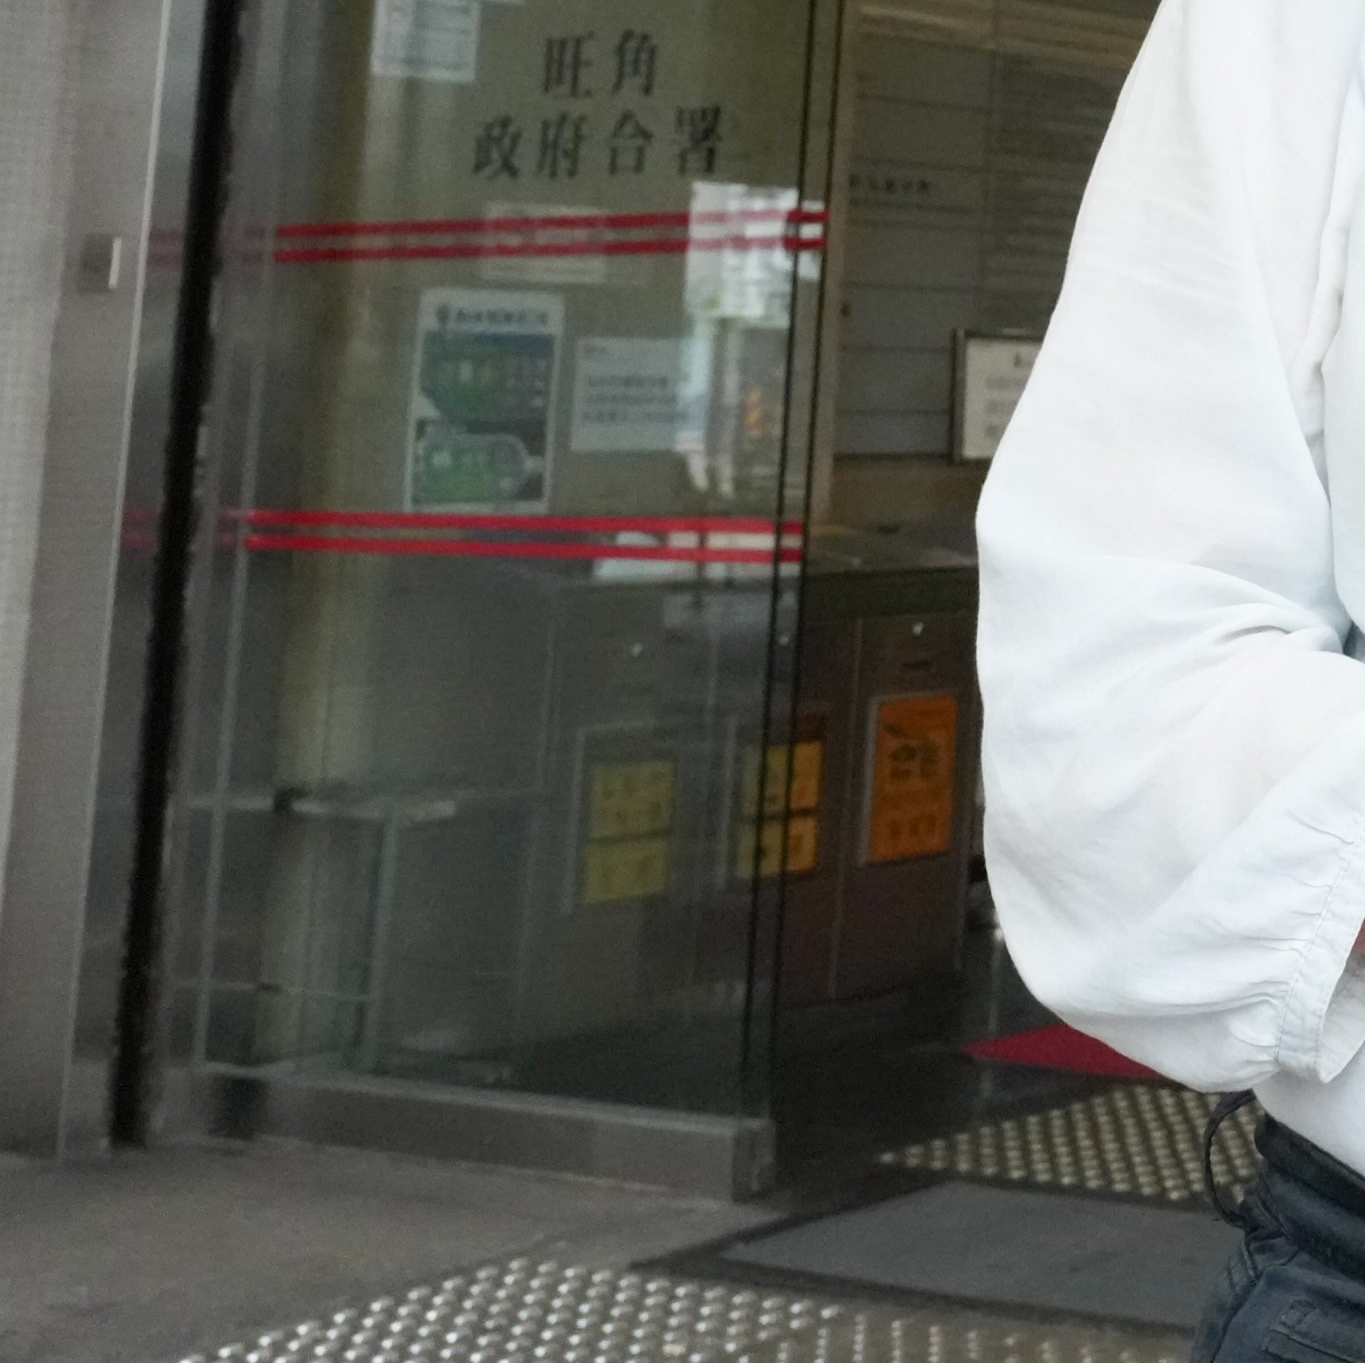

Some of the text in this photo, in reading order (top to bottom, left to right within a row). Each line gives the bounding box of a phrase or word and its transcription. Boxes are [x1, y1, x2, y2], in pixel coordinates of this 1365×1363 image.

[544, 29, 656, 99] 旺角
[472, 104, 722, 179] 政府合署
